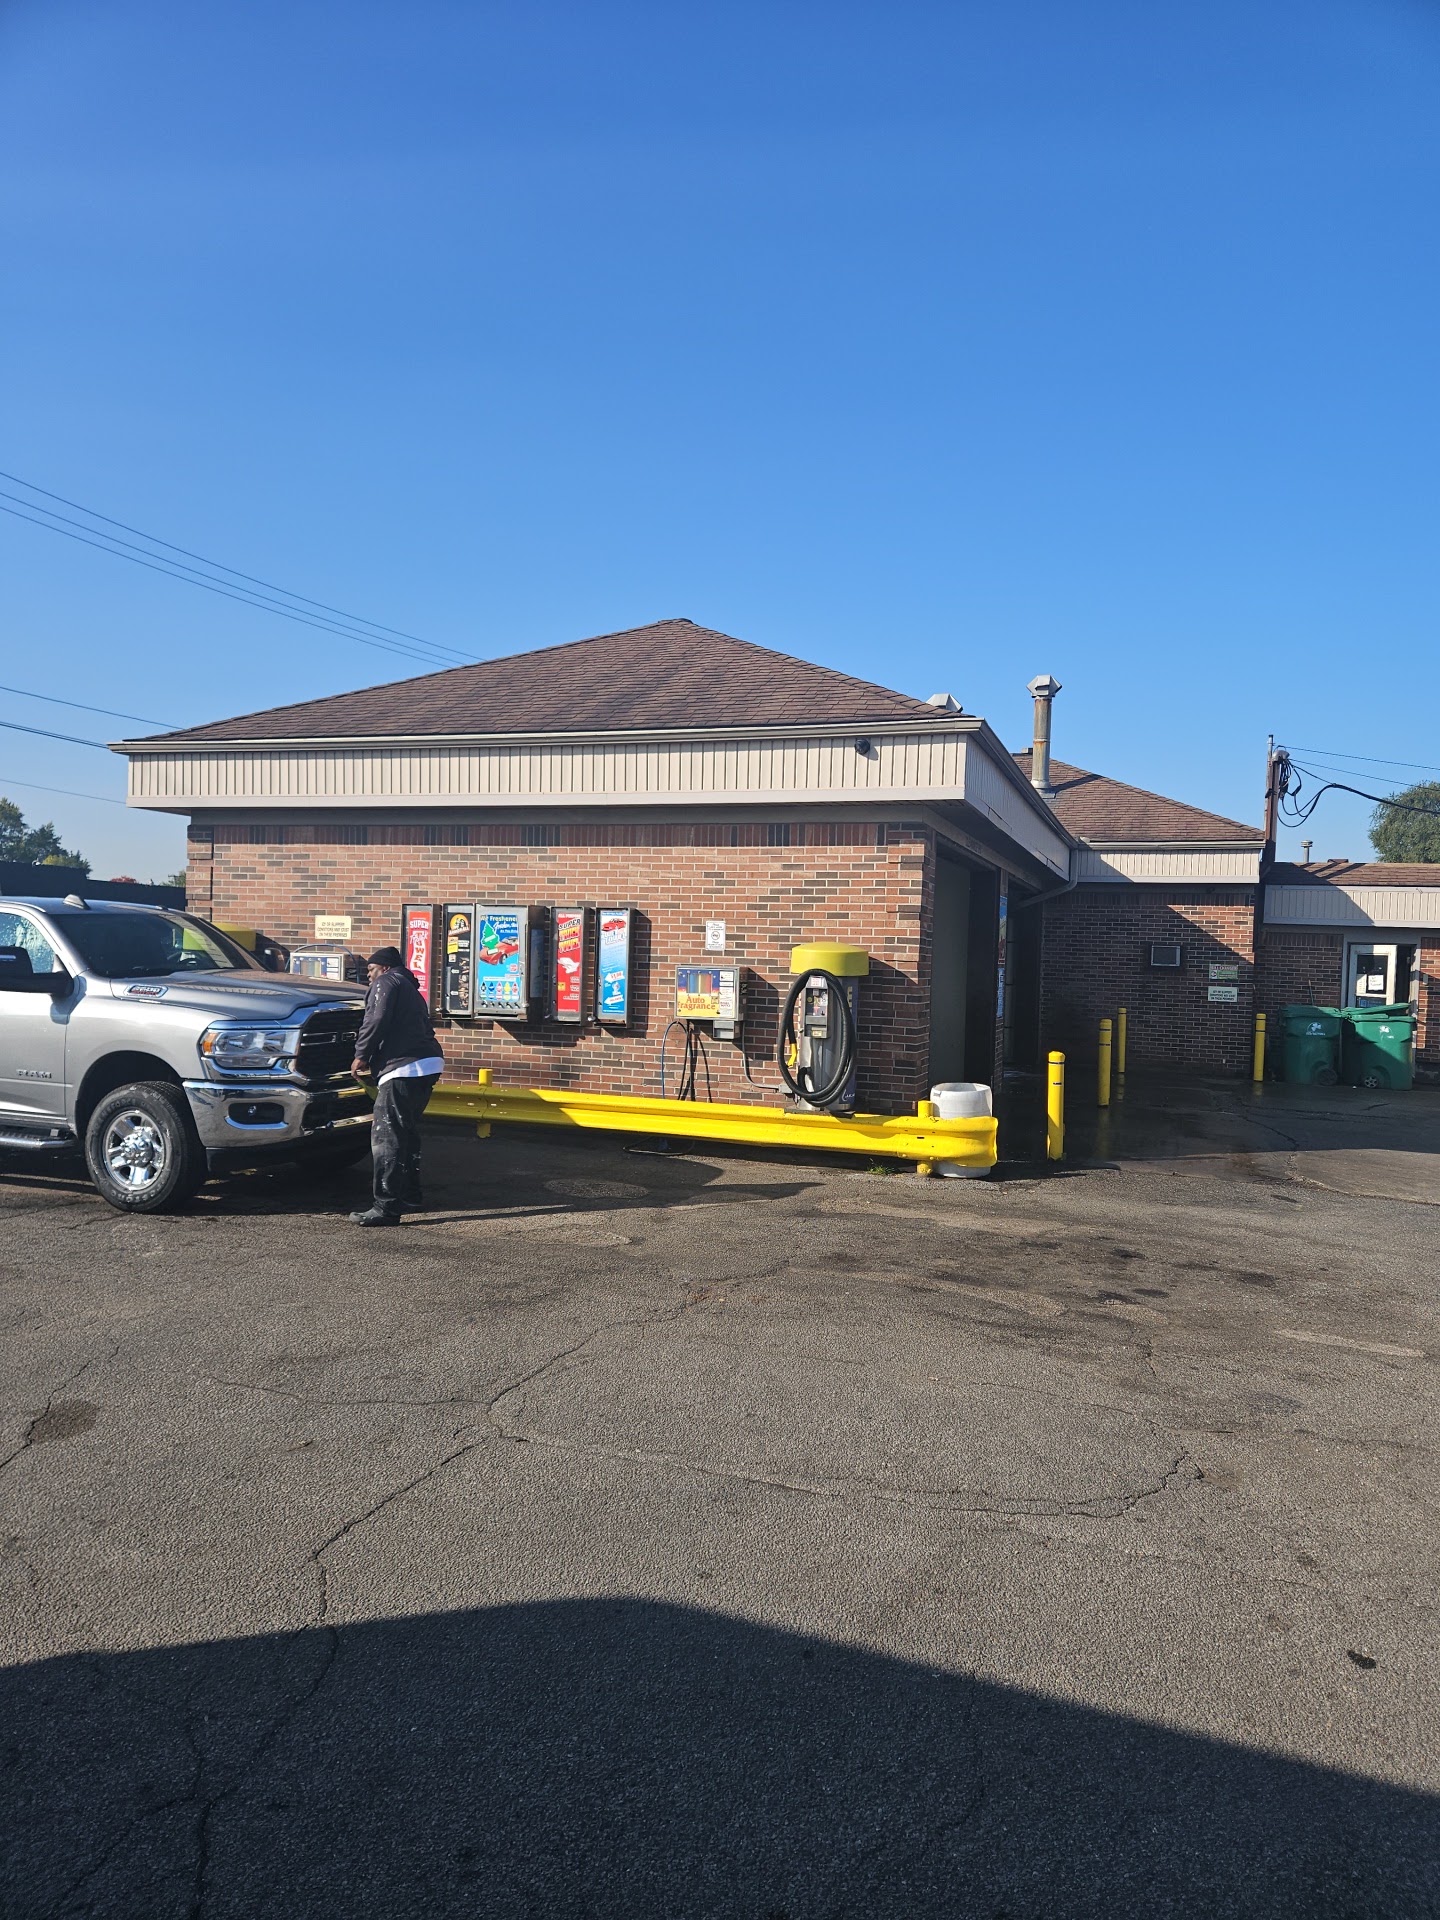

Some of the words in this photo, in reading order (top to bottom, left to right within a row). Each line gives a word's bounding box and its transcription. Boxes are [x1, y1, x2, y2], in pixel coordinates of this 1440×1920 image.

[410, 920, 429, 929] SUPER
[558, 919, 580, 930] SUPER
[413, 932, 425, 970] TOWEL
[677, 1001, 716, 1010] fragrance
